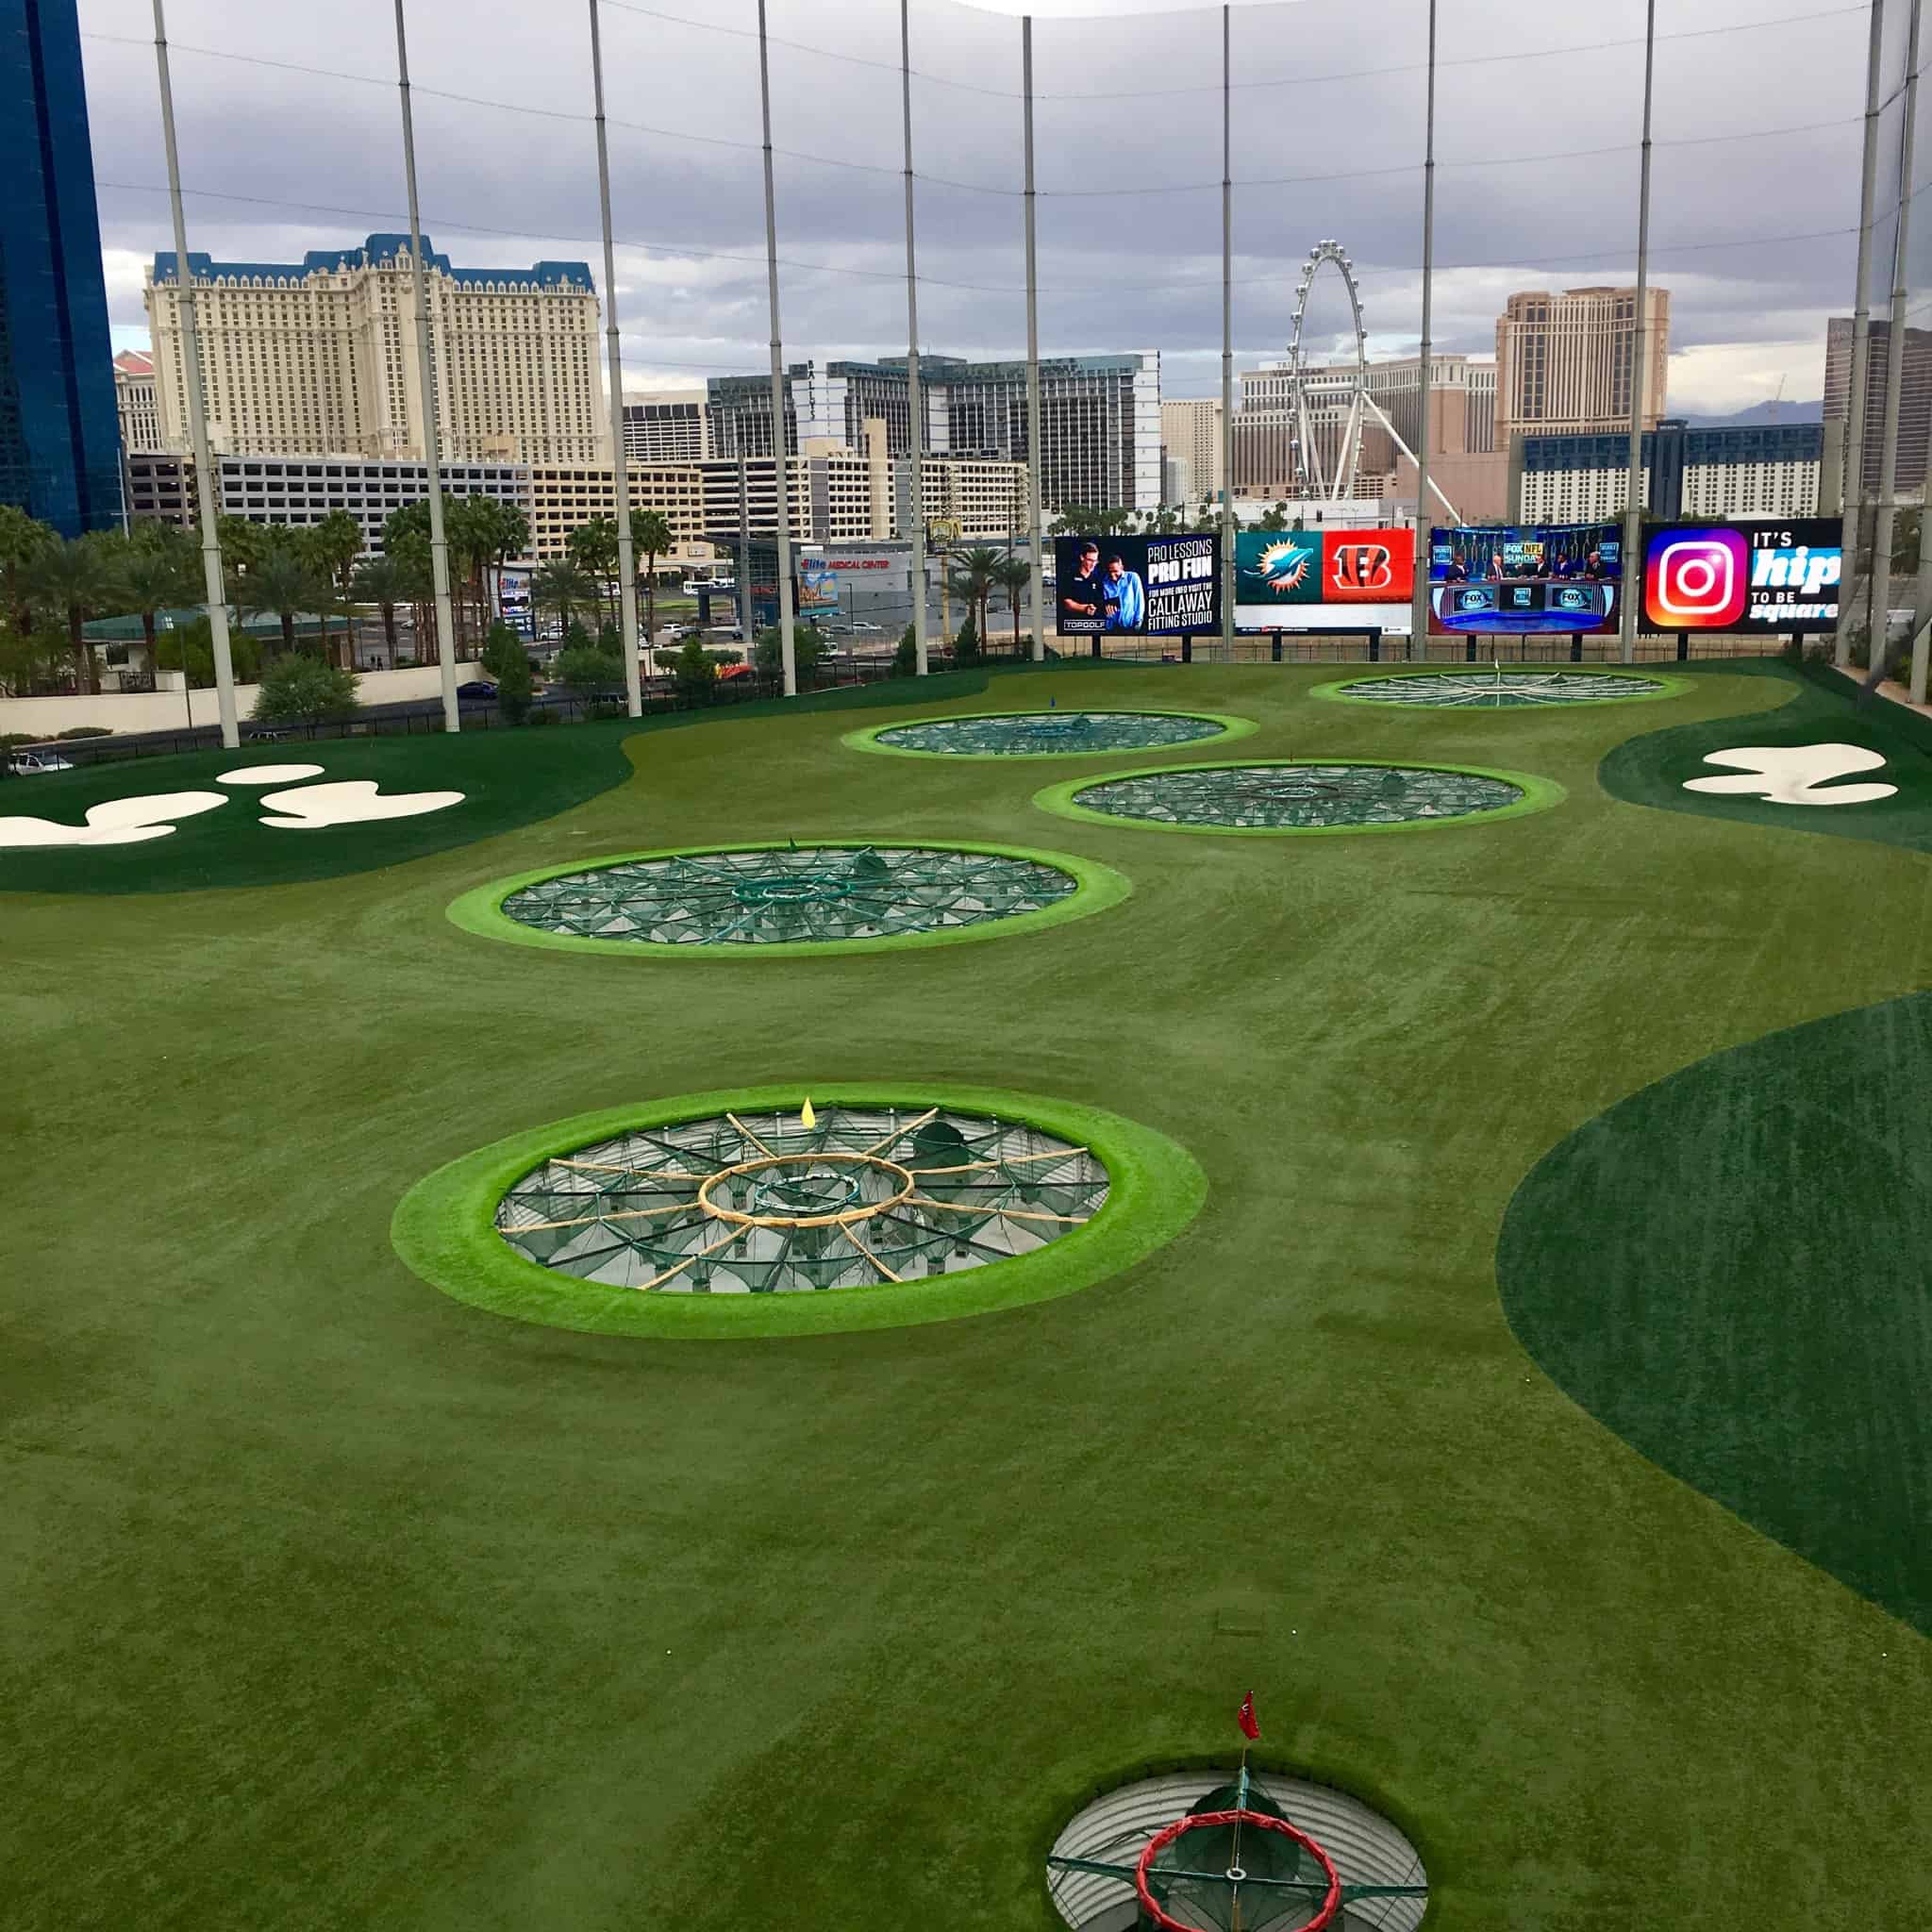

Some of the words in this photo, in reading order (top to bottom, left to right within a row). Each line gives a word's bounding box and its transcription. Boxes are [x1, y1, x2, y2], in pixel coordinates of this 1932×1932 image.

[1506, 544, 1524, 554] FOX
[1525, 543, 1541, 553] NFL
[1754, 531, 1792, 548] IT'S
[1147, 545, 1167, 563] PRO
[1169, 539, 1212, 560] LESSONS
[1148, 560, 1179, 585] PRO
[1182, 556, 1212, 580] FUN
[1751, 545, 1841, 594] hip
[1148, 591, 1212, 617] CALLAWAY
[1465, 594, 1482, 603] FOX
[1562, 593, 1580, 602] FOX
[1751, 591, 1770, 604] TO
[1775, 591, 1795, 604] BE
[1148, 614, 1179, 631] FITTING
[1182, 610, 1212, 626] STUDIO
[1749, 604, 1839, 623] square
